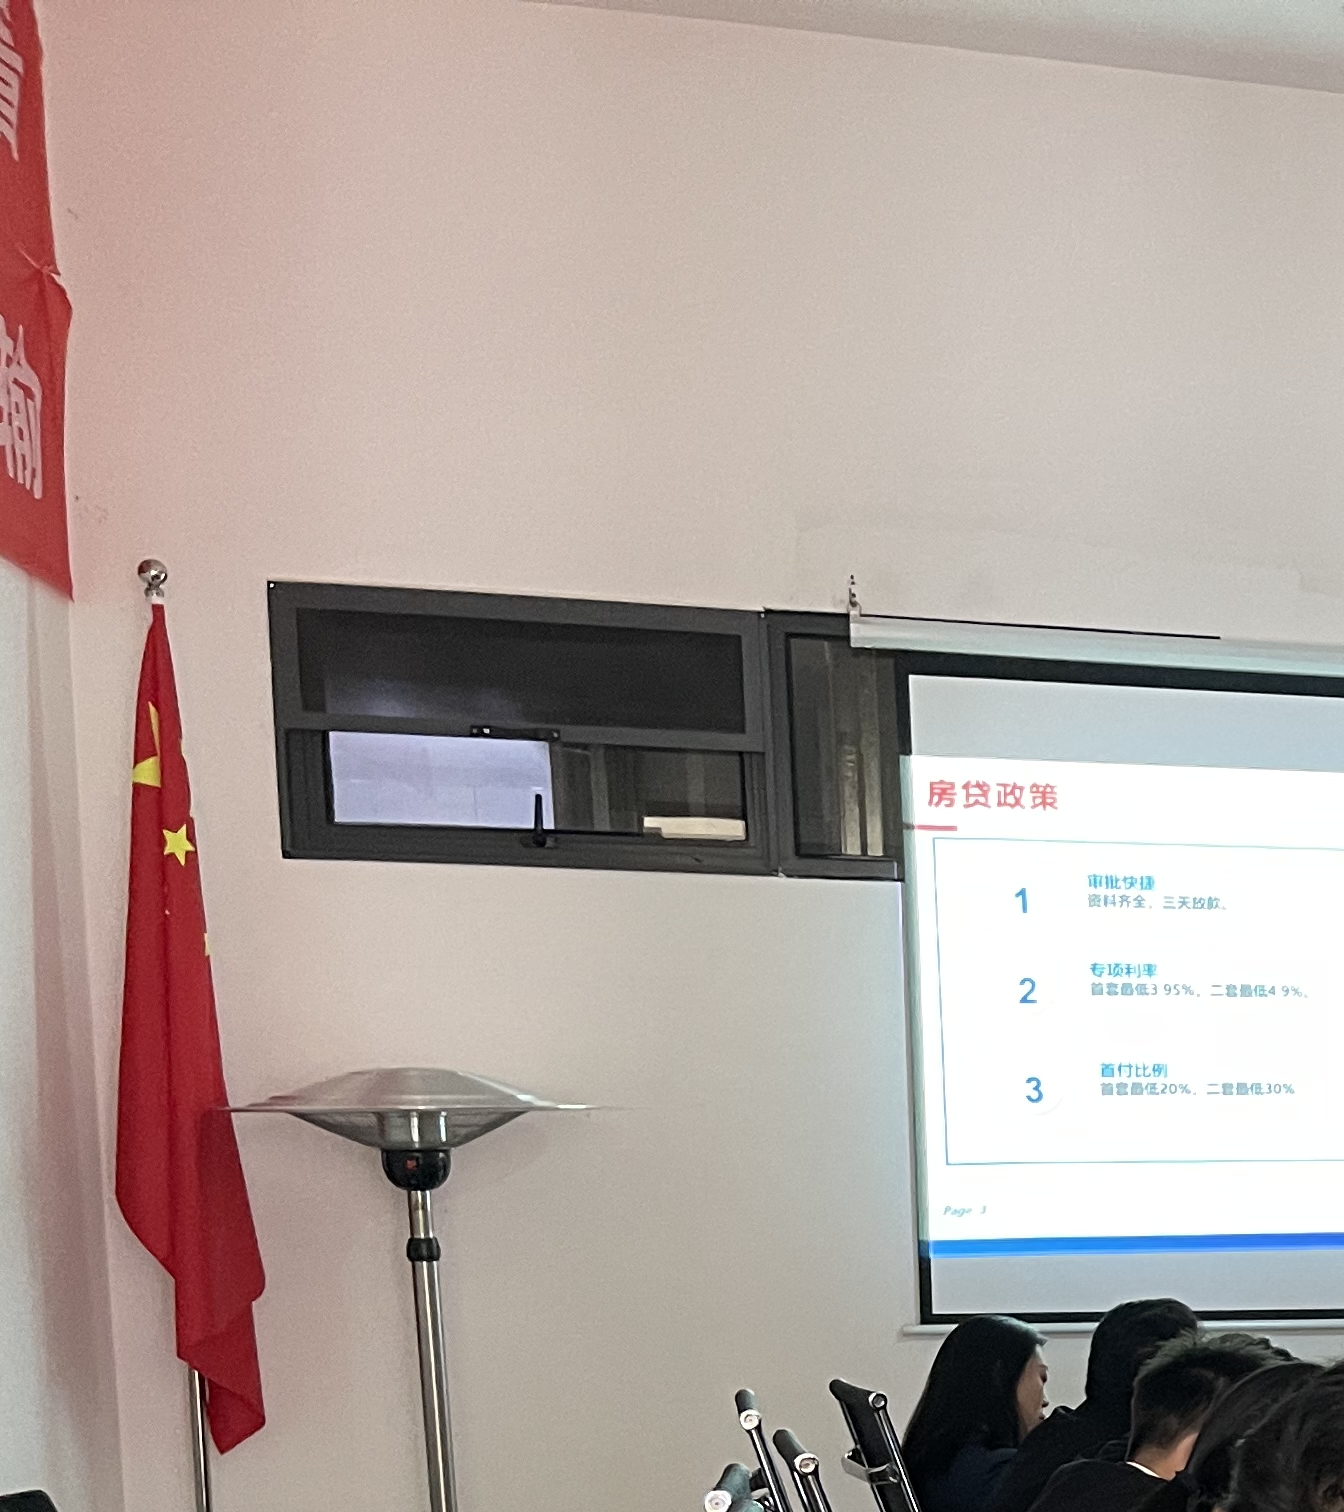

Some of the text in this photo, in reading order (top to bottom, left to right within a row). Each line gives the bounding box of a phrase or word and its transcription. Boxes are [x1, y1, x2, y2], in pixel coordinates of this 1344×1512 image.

[927, 779, 1059, 811] 房贷政策
[1087, 873, 1156, 891] 审批快捷
[1014, 887, 1028, 914] 1
[1090, 962, 1158, 979] 专项利率
[1019, 977, 1038, 1004] 2
[1099, 1061, 1169, 1079] 首付比例
[1025, 1076, 1044, 1104] 3
